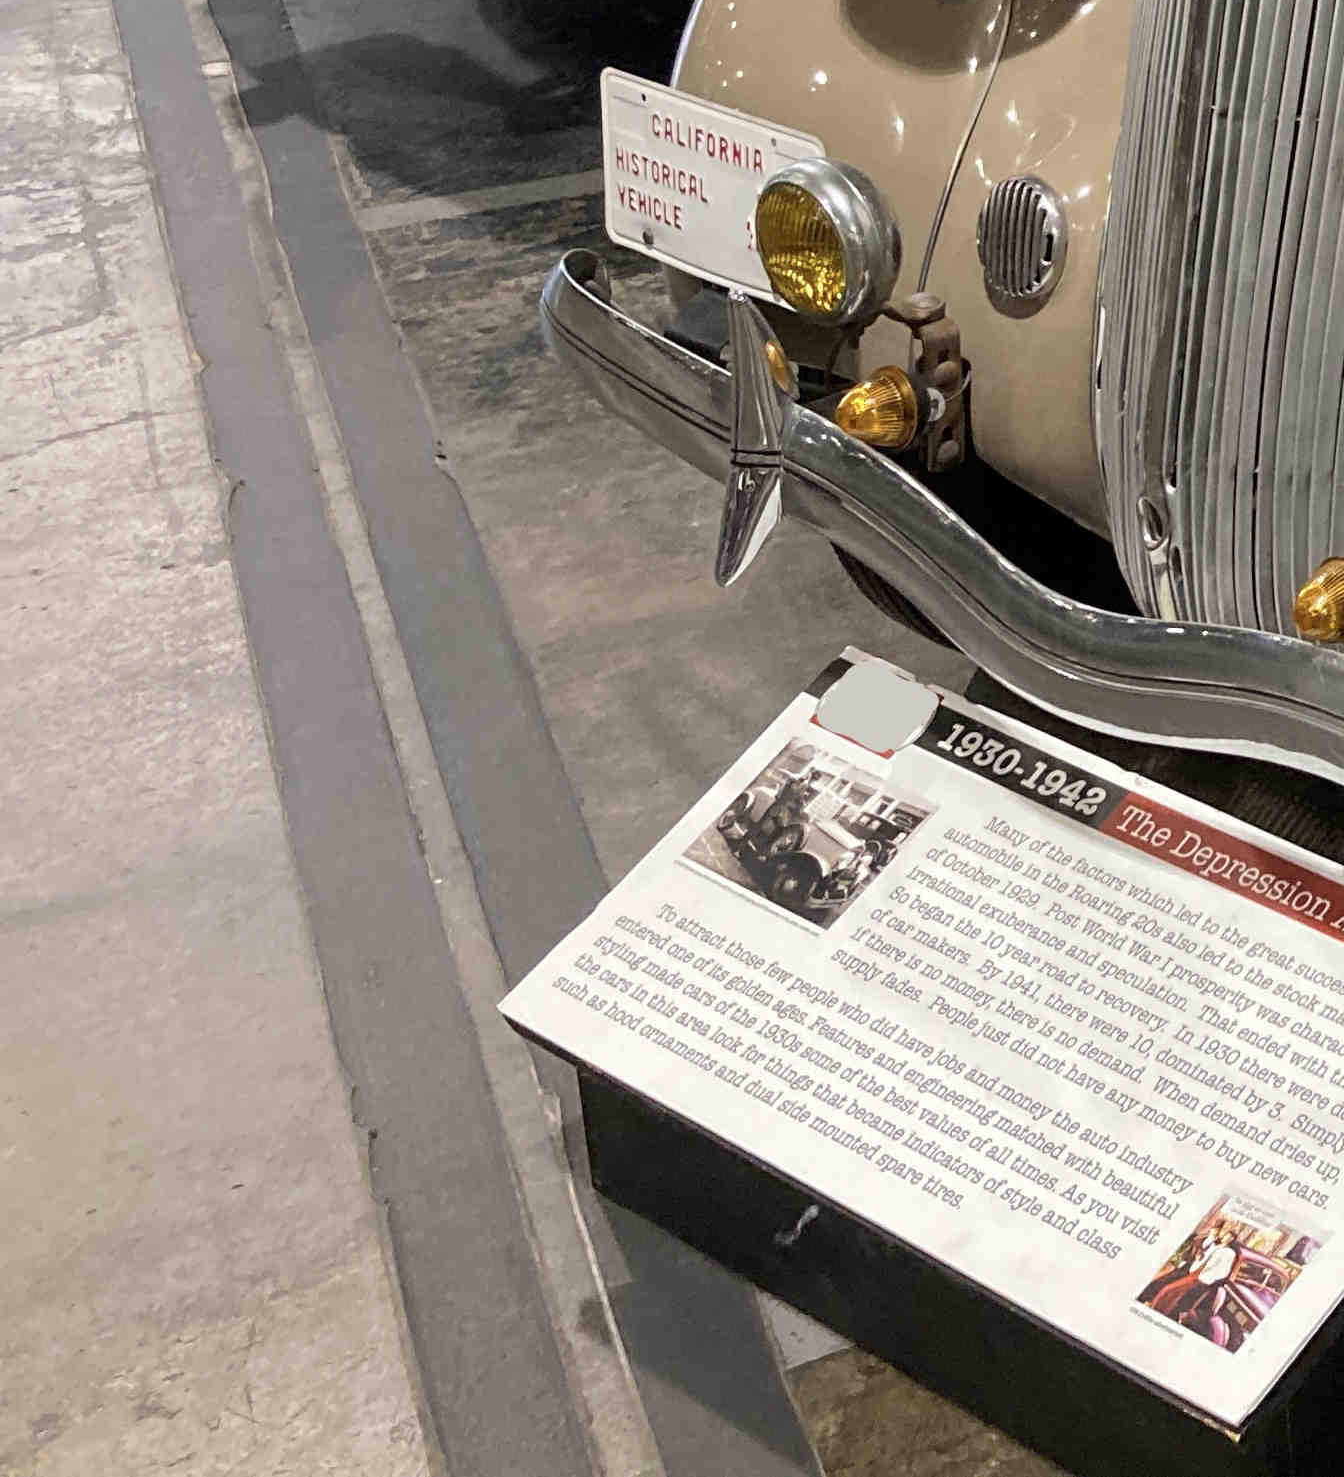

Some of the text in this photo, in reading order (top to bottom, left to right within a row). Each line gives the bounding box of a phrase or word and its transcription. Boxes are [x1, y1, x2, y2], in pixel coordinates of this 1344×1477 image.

[651, 112, 764, 173] CALIFORNIA
[615, 146, 710, 204] HISTORICAL
[617, 183, 683, 230] VEHICLE
[936, 723, 1108, 817] 1930-1942
[1118, 804, 1172, 851] The
[1168, 827, 1330, 922] Depression
[924, 846, 950, 864] of
[941, 852, 1002, 890] October
[942, 827, 1025, 873] automobile
[1020, 862, 1042, 881] in
[1032, 870, 1071, 895] the
[1066, 883, 1137, 928] Roaring
[1129, 913, 1166, 939] 20s
[1160, 930, 1199, 956] also
[1194, 942, 1228, 969] led
[1222, 956, 1245, 977] to
[1242, 966, 1275, 991] the
[1271, 982, 1322, 1014] stock
[982, 815, 1032, 849] Many
[1027, 838, 1053, 855] of
[1044, 844, 1074, 868] the
[1070, 856, 1128, 893] factors
[1126, 883, 1176, 916] which
[1171, 902, 1205, 929] led
[1199, 915, 1222, 936] to
[1218, 925, 1251, 950] the
[1244, 941, 1296, 972] great
[997, 879, 1042, 911] 1929.
[1042, 900, 1082, 930] Post
[1080, 917, 1130, 952] World
[1126, 938, 1163, 967] War
[905, 864, 983, 911] irrational
[977, 902, 1067, 952] exuberance
[1063, 943, 1102, 969] and
[1095, 959, 1189, 1013] speculation.
[1195, 1003, 1239, 1035] That
[1235, 1026, 1292, 1060] ended
[1288, 1050, 1330, 1080] with
[1156, 955, 1176, 973] I
[1165, 963, 1257, 1014] prosperity
[868, 907, 895, 925] of
[884, 915, 917, 937] car
[910, 928, 973, 967] makers.
[974, 957, 1004, 982] By
[999, 969, 1043, 1005] 1941,
[1042, 991, 1090, 1024] there
[1087, 1014, 1130, 1044] were
[1126, 1032, 1156, 1061] 10,
[1154, 1047, 1248, 1101] dominated
[1241, 1087, 1271, 1115] by
[1266, 1100, 1288, 1123] 3.
[887, 884, 912, 906] So
[907, 893, 956, 928] began
[952, 916, 983, 941] the
[979, 930, 1006, 951] 10
[996, 942, 1042, 969] year
[1036, 960, 1081, 989] road
[1075, 976, 1098, 997] to
[1093, 988, 1171, 1034] recovery.
[1171, 1022, 1196, 1047] In
[1193, 1034, 1242, 1067] 1930
[1237, 1055, 1287, 1090] there
[1286, 1080, 1331, 1111] were
[1255, 1003, 1292, 1030] was
[829, 948, 1330, 1211] supply fades. People just did not have any money to buy new cars.
[848, 924, 1342, 1187] if there is no money, there is no demand. When demand dries up,
